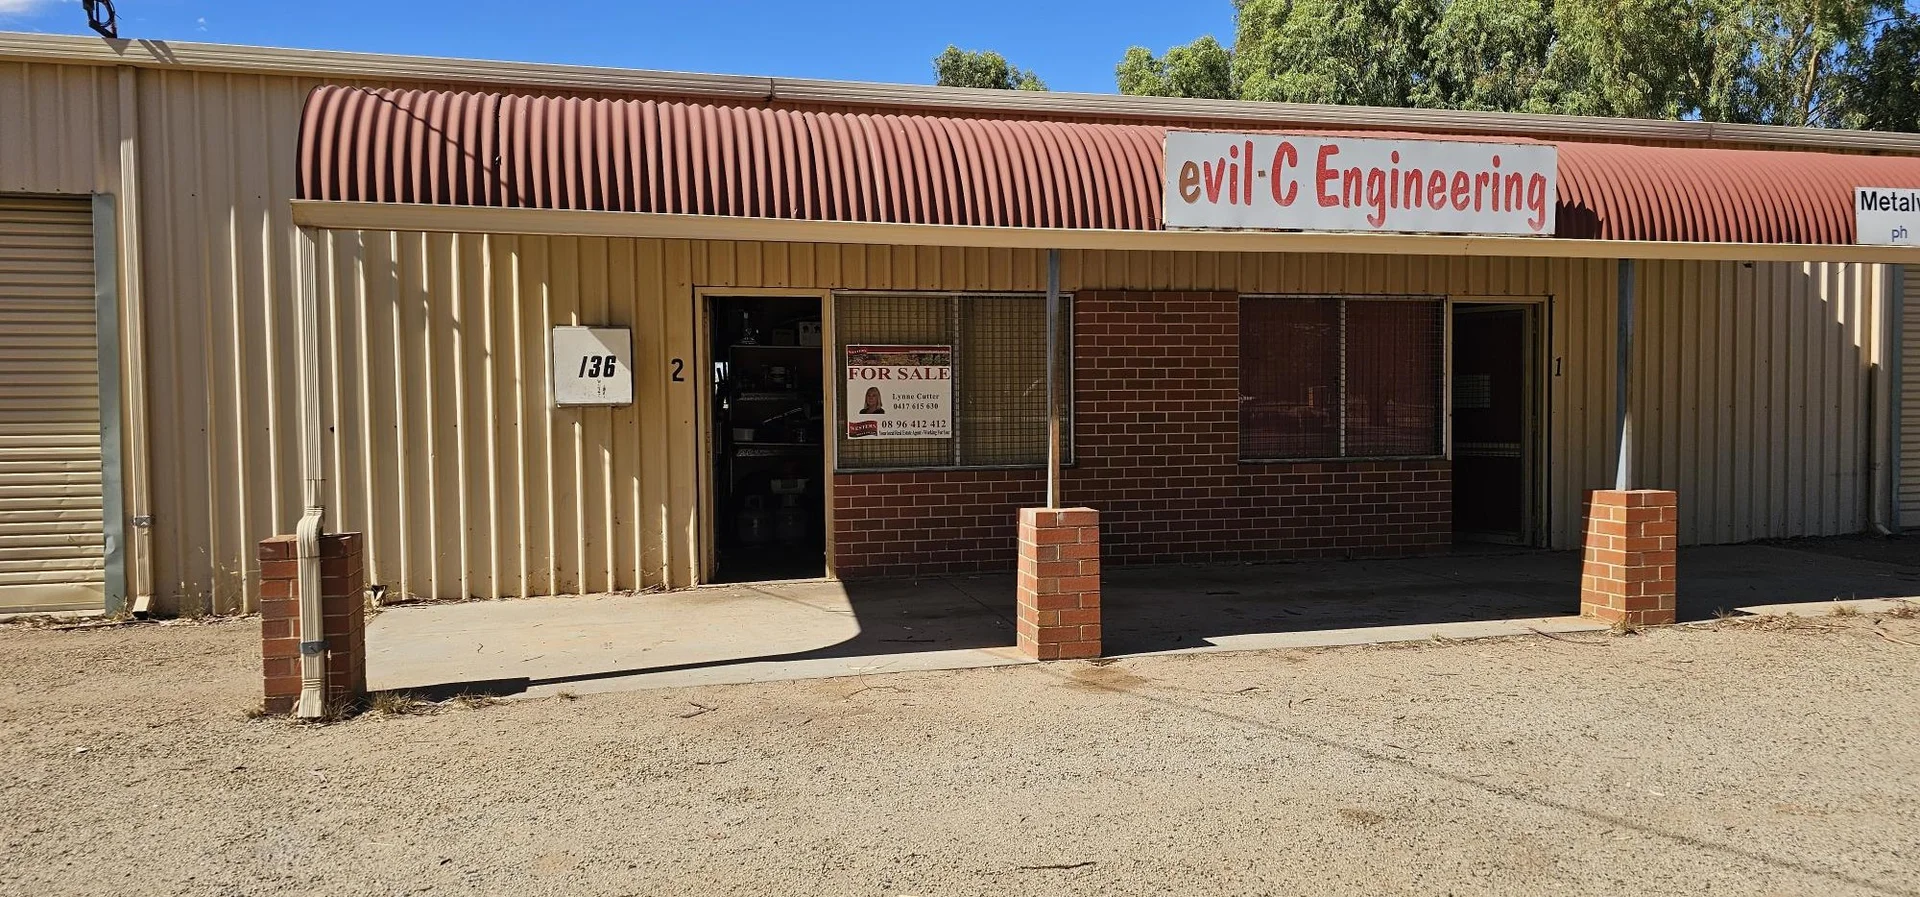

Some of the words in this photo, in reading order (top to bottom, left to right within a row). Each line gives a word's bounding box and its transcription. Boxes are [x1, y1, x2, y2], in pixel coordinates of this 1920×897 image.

[1315, 144, 1547, 231] Engineering
[1861, 190, 1920, 212] Metal
[1892, 225, 1907, 242] ph
[579, 355, 617, 378] 136
[671, 358, 685, 382] 2
[848, 367, 892, 380] FOR
[897, 367, 950, 380] SALE
[1555, 356, 1562, 377] 1
[892, 393, 915, 401] Lynne
[881, 420, 893, 428] 08
[896, 420, 908, 428] 96
[910, 420, 927, 428] 412
[930, 420, 947, 428] 412
